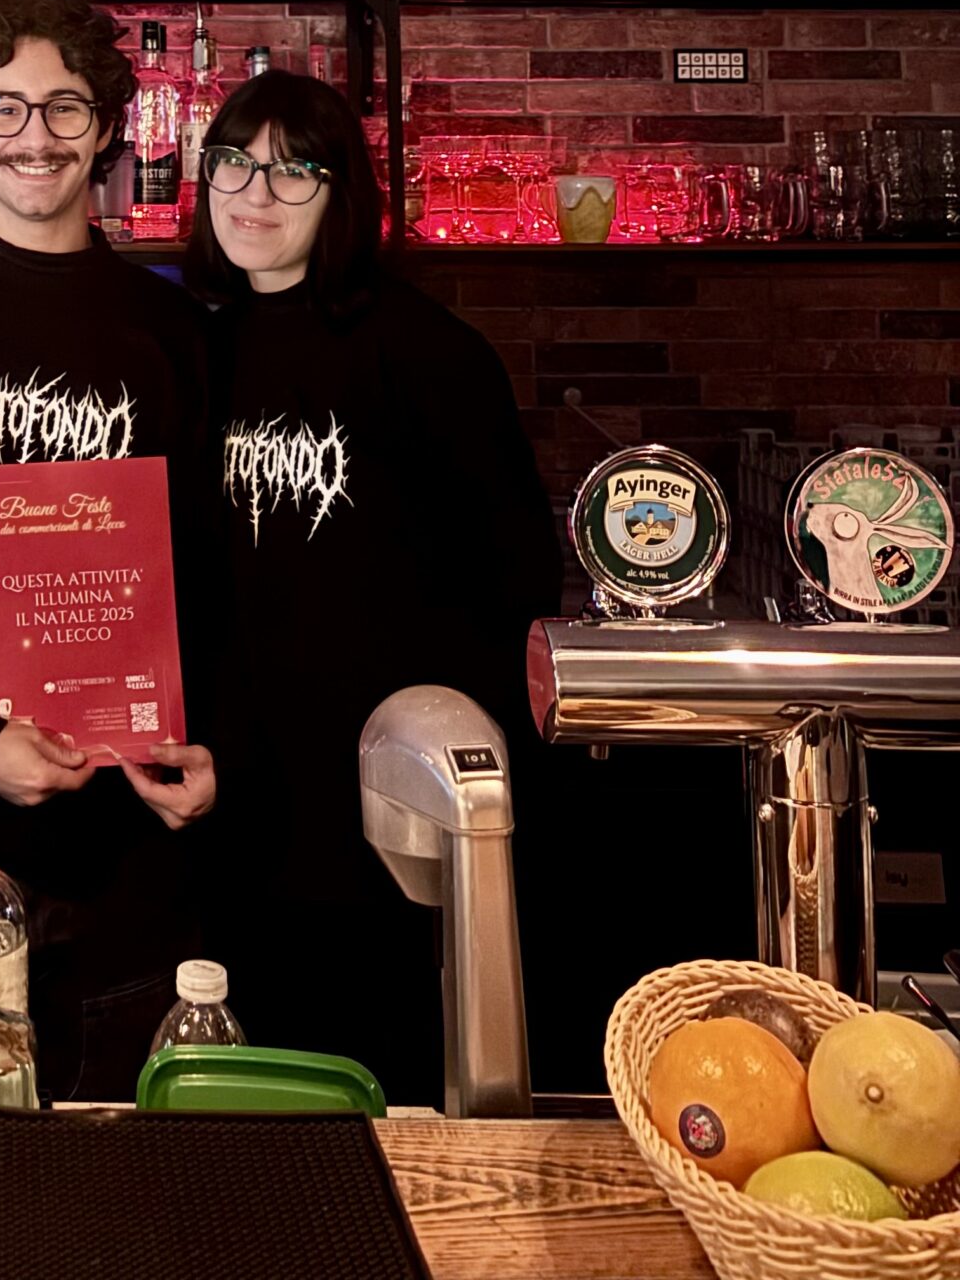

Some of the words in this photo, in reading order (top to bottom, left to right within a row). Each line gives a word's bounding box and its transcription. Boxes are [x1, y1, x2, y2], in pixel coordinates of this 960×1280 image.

[680, 54, 742, 65] SOTTO
[680, 67, 742, 78] FONDO
[613, 474, 691, 502] Ayinger
[61, 492, 112, 519] Feste
[18, 519, 81, 534] commercianti
[81, 519, 93, 531] di
[94, 513, 127, 534] Lecco
[619, 541, 651, 561] LAGER
[653, 545, 679, 561] HELL
[1, 572, 65, 593] QUESTA
[68, 567, 144, 587] ATTIVITA'
[34, 589, 114, 608] ILLUMINA
[833, 586, 852, 603] BIRRA
[860, 598, 878, 607] STILE
[15, 612, 30, 628] IL
[33, 608, 96, 627] NATALE
[100, 606, 135, 623] 2025
[40, 631, 53, 645] A
[56, 626, 112, 644] LECCO
